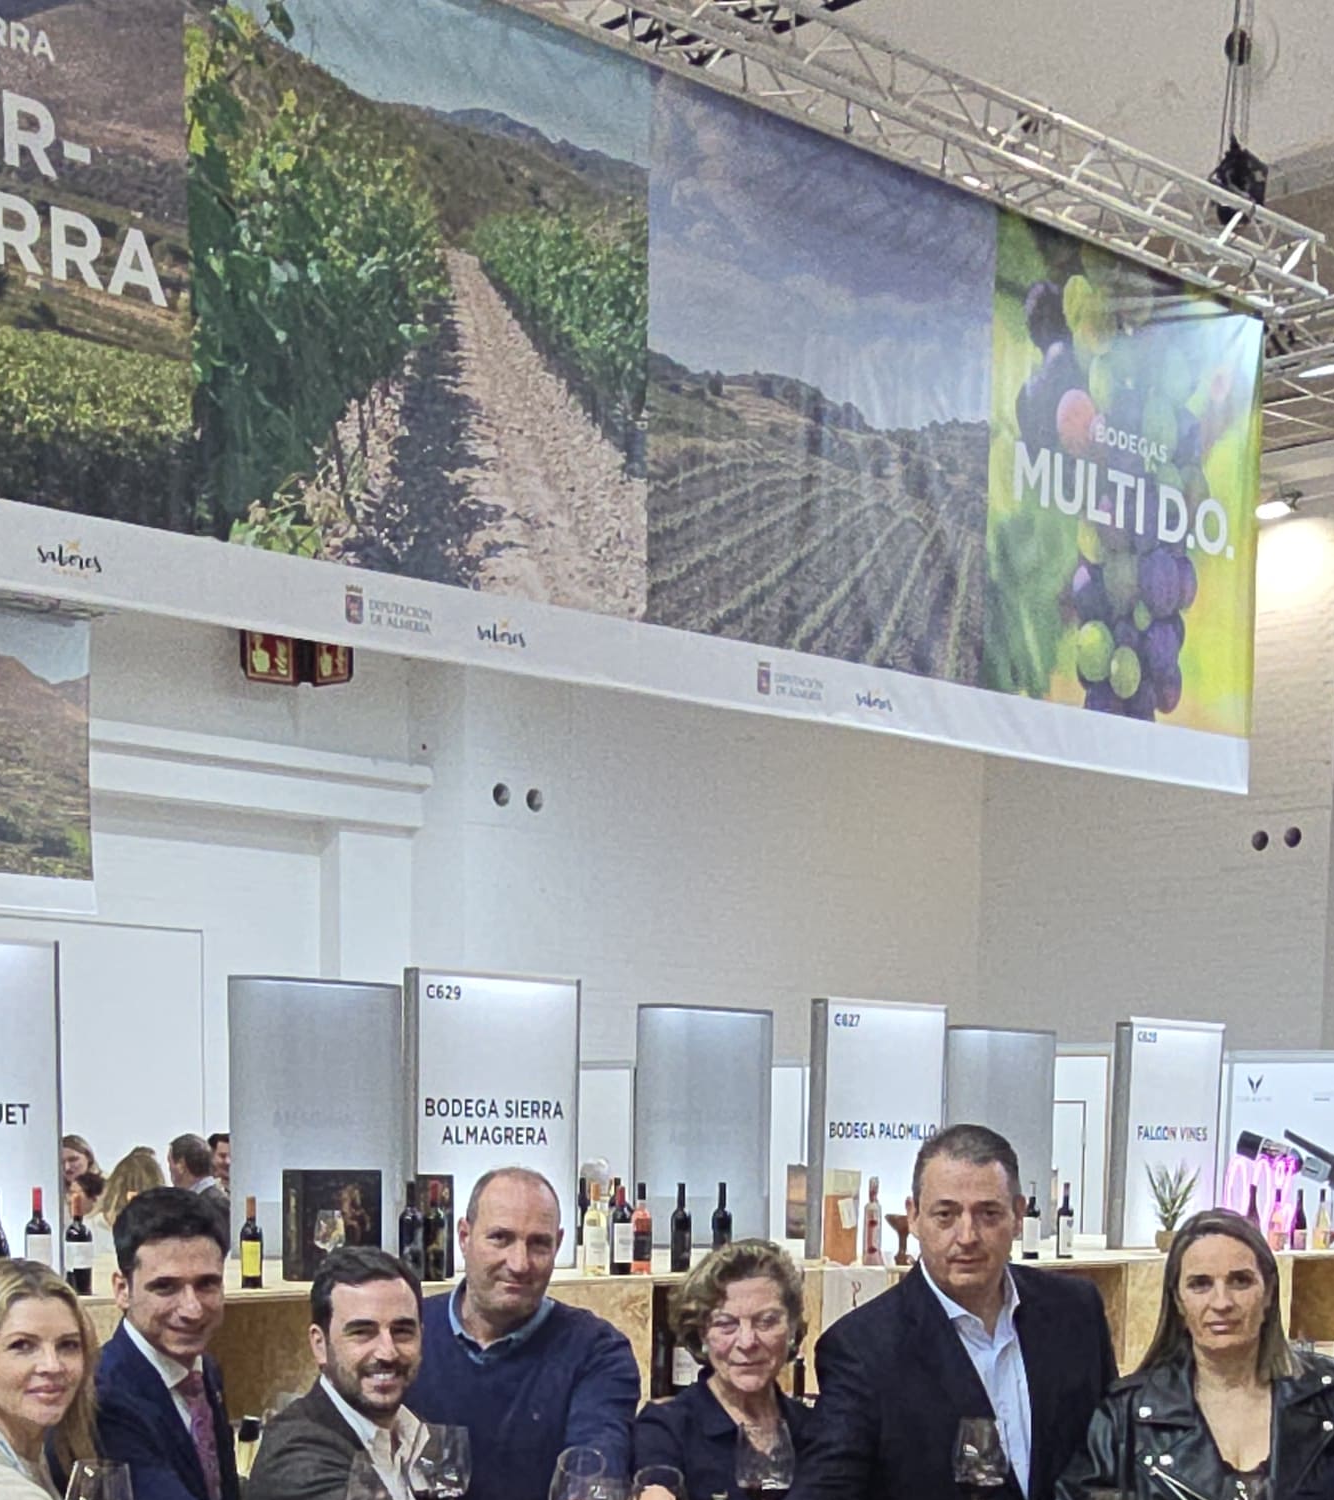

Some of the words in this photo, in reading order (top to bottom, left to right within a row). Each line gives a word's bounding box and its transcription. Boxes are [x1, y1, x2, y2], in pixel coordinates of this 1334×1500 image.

[1096, 423, 1168, 464] BODEGAS
[1014, 440, 1145, 535] MULTI
[1157, 484, 1235, 560] D.O.
[425, 984, 462, 1000] C629
[424, 1098, 498, 1119] BODEGA
[505, 1100, 565, 1121] SIERRA
[441, 1126, 548, 1146] ALMAGRERA
[829, 1121, 876, 1139] BODEGA
